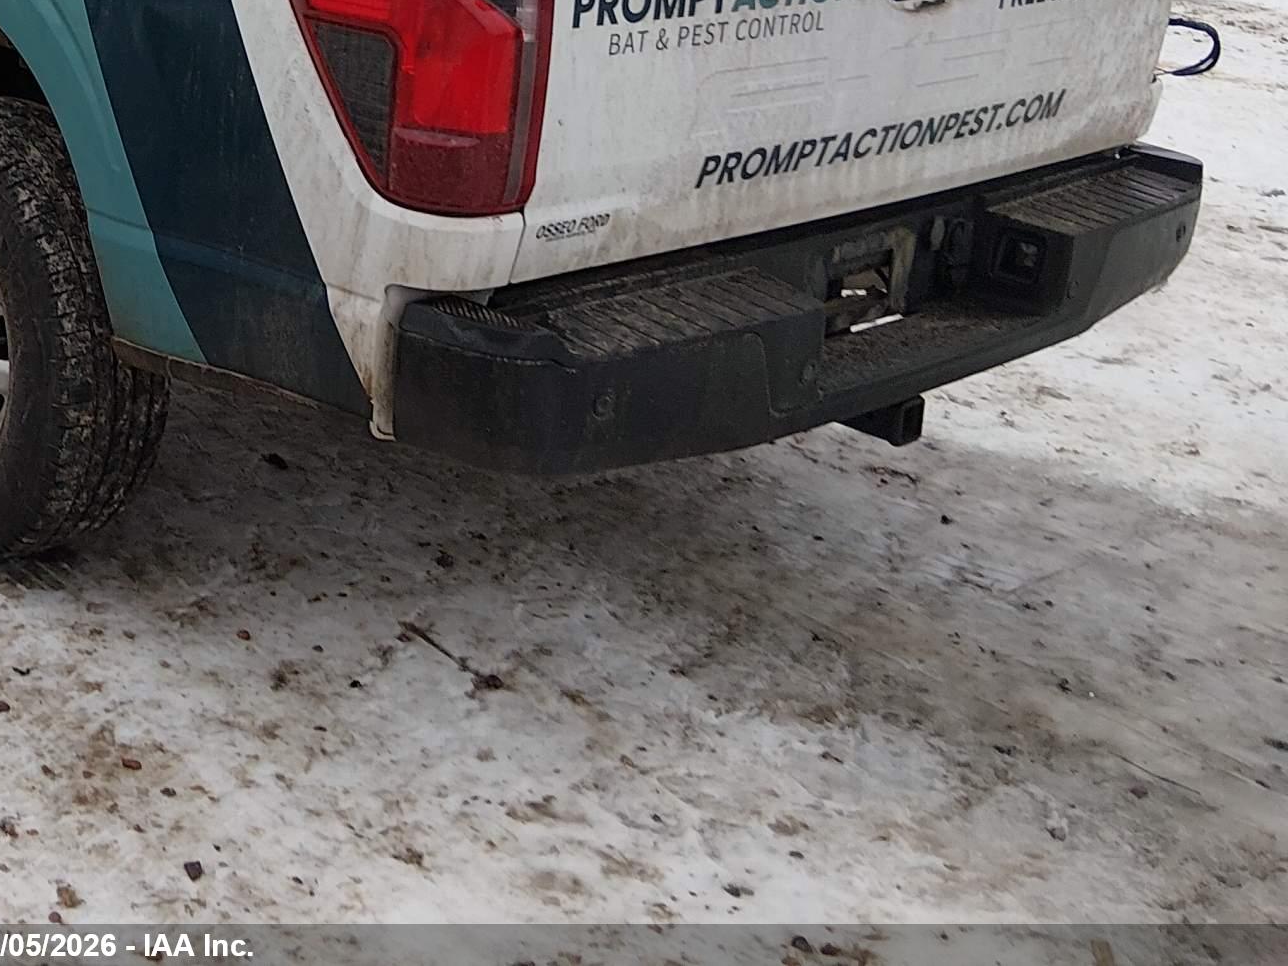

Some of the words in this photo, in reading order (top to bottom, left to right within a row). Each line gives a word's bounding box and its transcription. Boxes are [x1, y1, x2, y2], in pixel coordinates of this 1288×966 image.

[607, 29, 650, 56] BAT
[655, 27, 669, 52] &
[676, 20, 729, 48] PEST
[734, 10, 825, 42] CONTROL
[693, 88, 1067, 190] PROMPTACTIONPEST.COM
